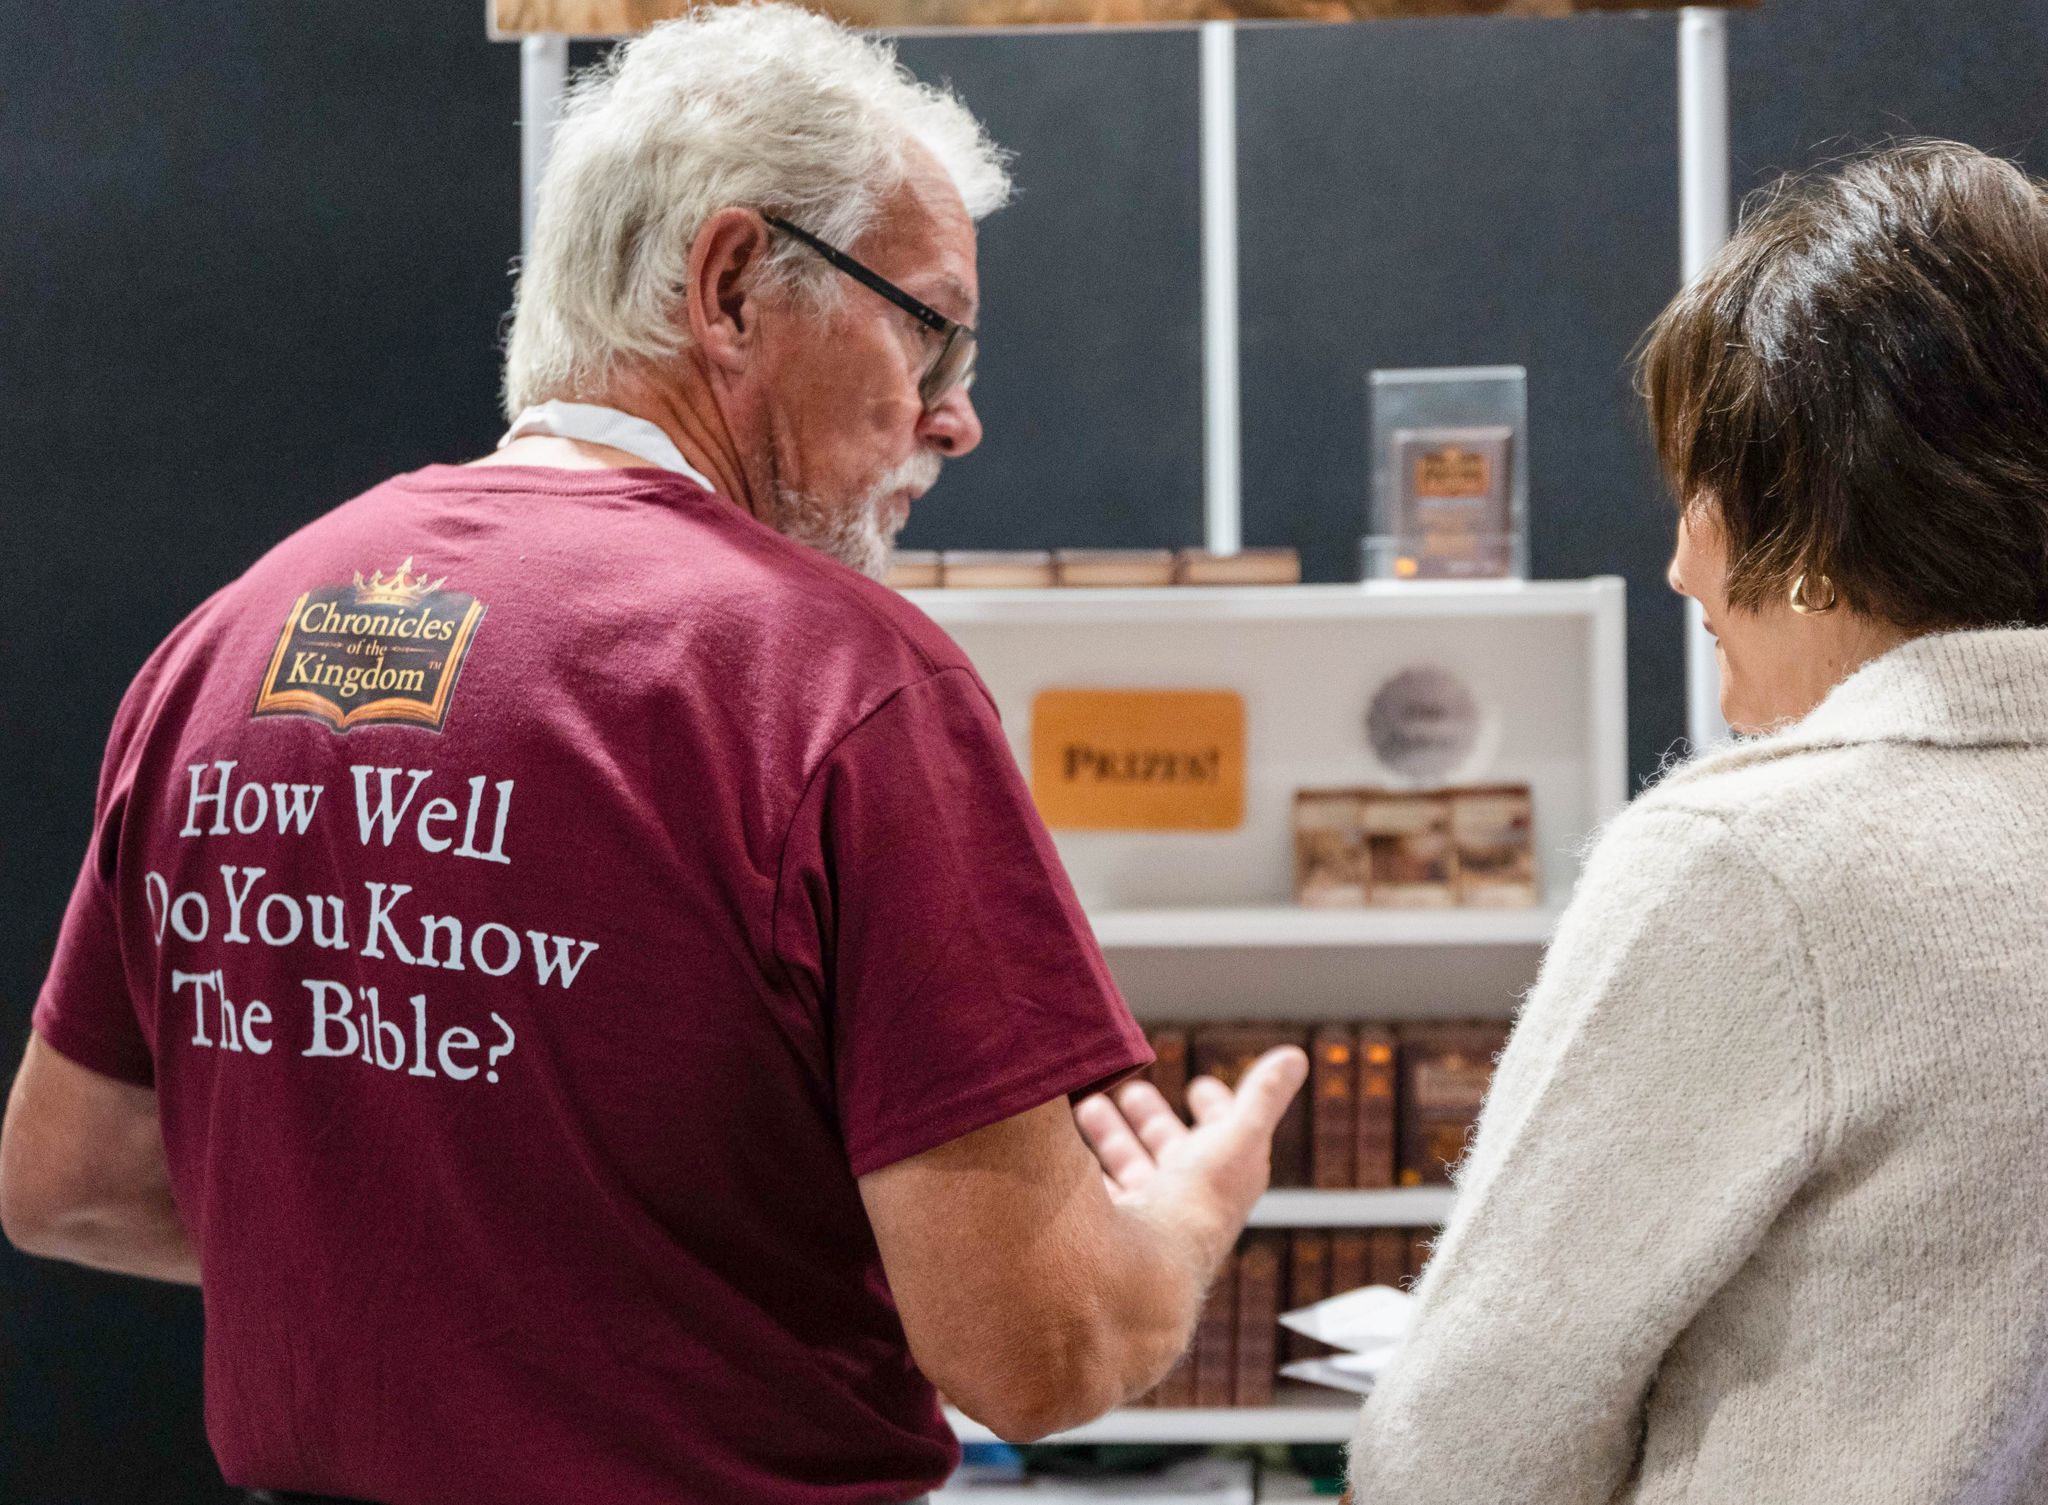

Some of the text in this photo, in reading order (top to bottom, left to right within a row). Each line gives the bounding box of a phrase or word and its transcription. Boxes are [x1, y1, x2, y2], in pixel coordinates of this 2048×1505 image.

[301, 602, 455, 641] Chronicles
[347, 639, 388, 656] of the
[287, 652, 425, 697] Kingdom
[179, 760, 515, 864] How Well
[220, 865, 349, 949] You
[360, 881, 599, 989] Know
[172, 969, 515, 1083] The Bible?
